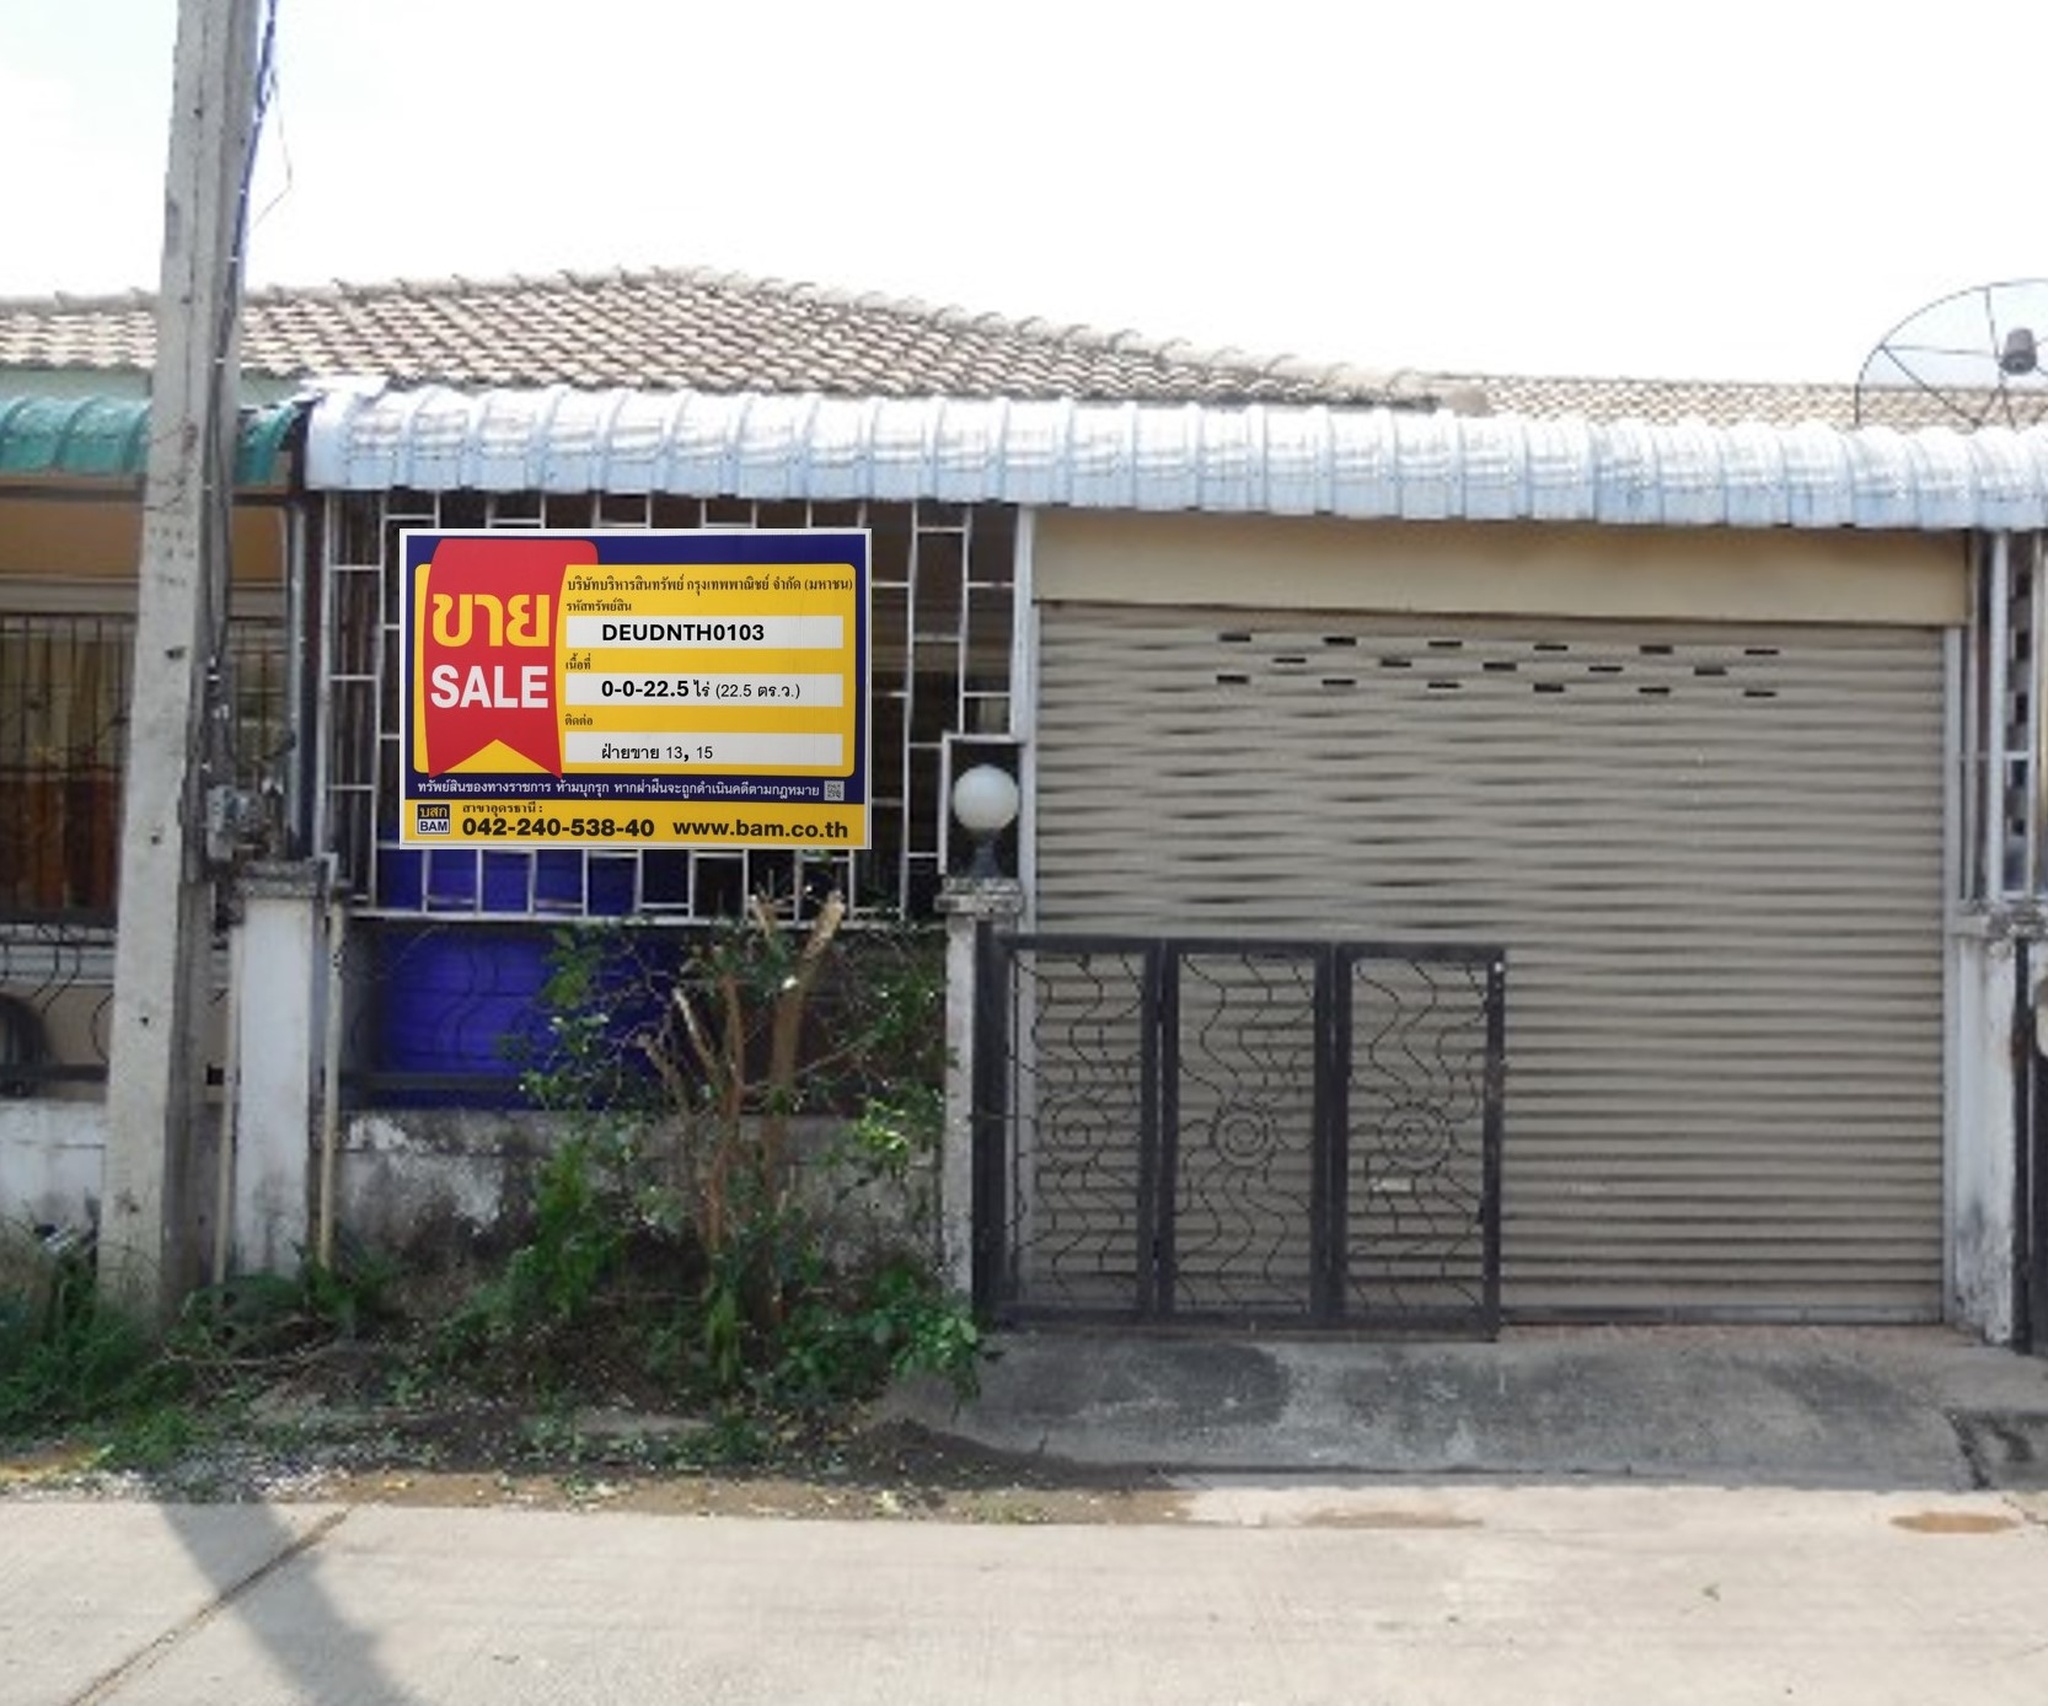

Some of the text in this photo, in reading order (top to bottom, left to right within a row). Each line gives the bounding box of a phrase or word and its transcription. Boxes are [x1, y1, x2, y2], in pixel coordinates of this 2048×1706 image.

[567, 574, 853, 596] บริษัทบริหารสินทรัพย์ กรุงเทพพาณิชย์ จำกัด (มหาชน)
[566, 598, 632, 612] รหัสทรัพย์สิน
[433, 594, 549, 646] ขาย
[602, 624, 765, 641] DEUDNTH0103
[566, 652, 591, 670] เนื้อที่
[431, 664, 548, 708] SALE
[601, 680, 689, 697] 0-0-22.5
[693, 679, 710, 697] ไร่
[715, 683, 752, 699] (22.5
[565, 714, 593, 726] ติดต่อ
[601, 743, 713, 761] ฝ่ายขาย 13, 15
[417, 778, 820, 799] ทรัพย์สินของทางราชการ ห้ามบุกรุก หากฝ่าฝืนจะถูกดำเนินคดีตามกฎหมาย
[419, 806, 448, 817] บสก
[419, 821, 448, 832] BAM
[462, 818, 848, 838] 042-240-538-40 www.bam.co.th
